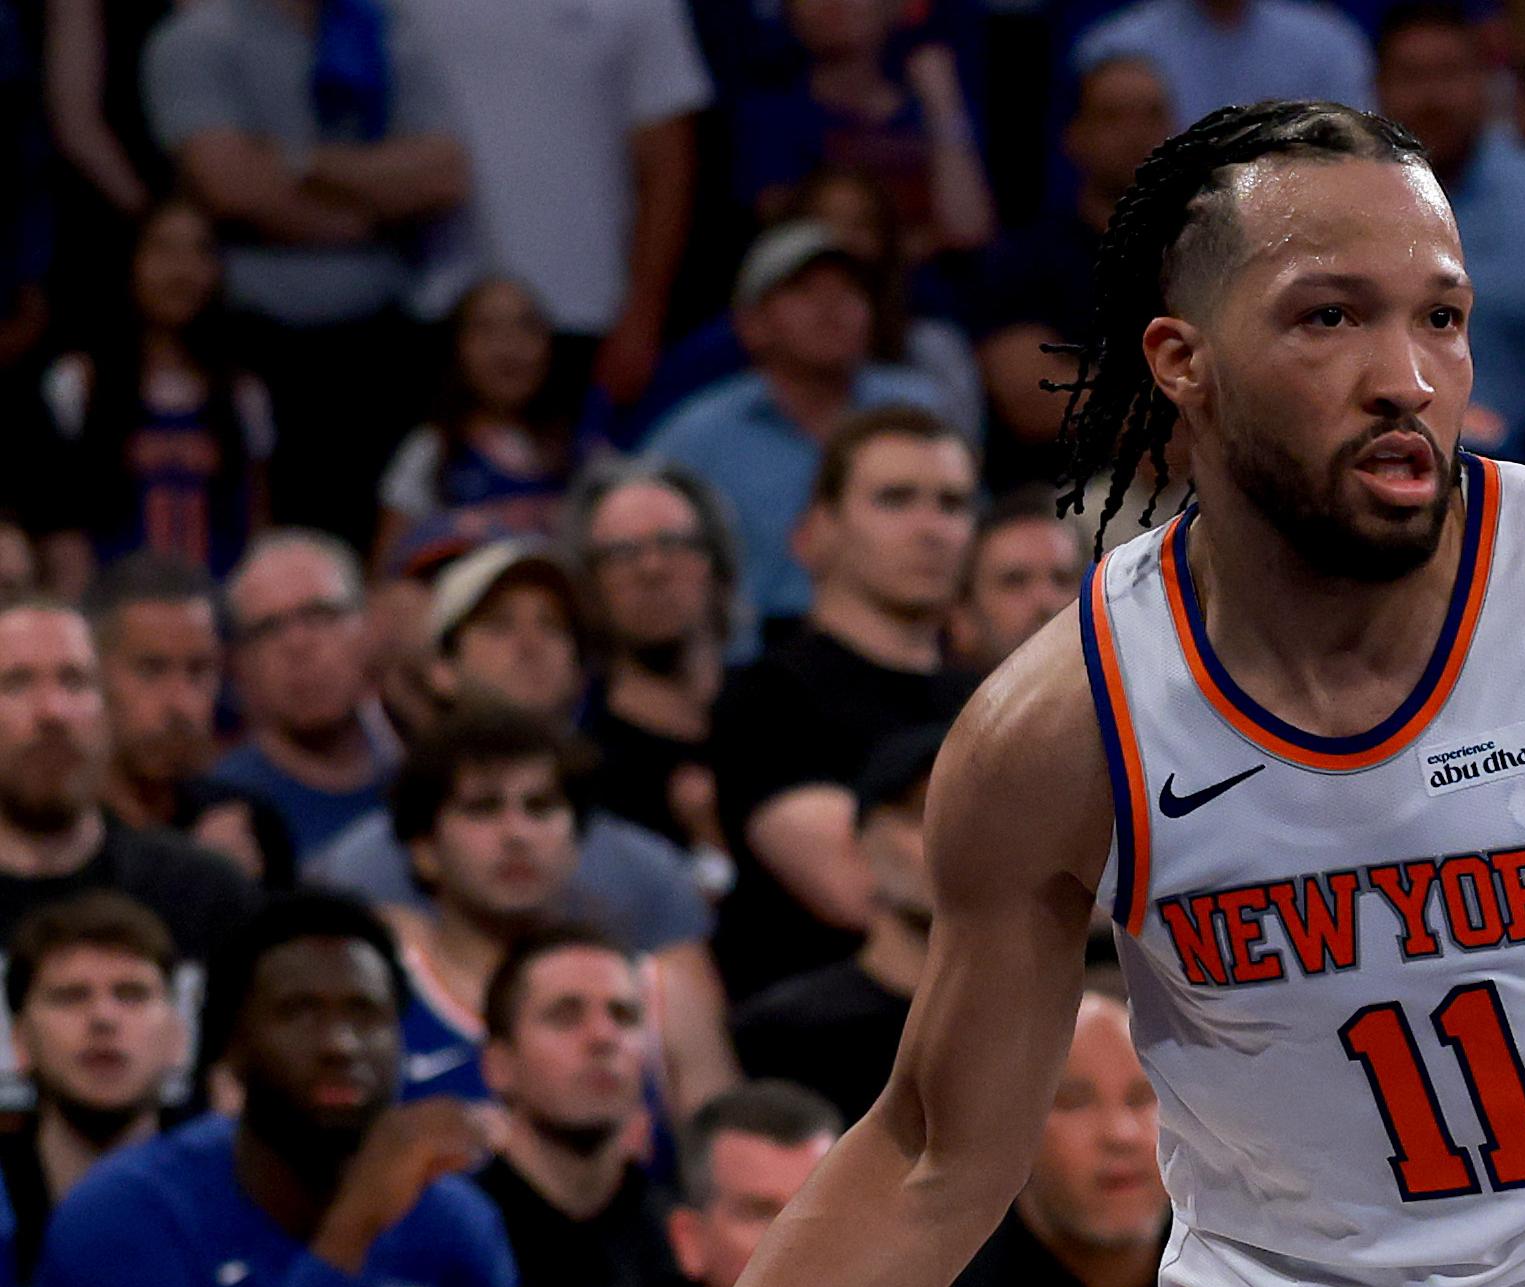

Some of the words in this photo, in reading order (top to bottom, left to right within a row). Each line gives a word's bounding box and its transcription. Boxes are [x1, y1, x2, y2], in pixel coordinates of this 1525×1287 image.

[1427, 740, 1496, 765] experience
[1430, 762, 1481, 788] abu
[1157, 869, 1362, 988] NEW
